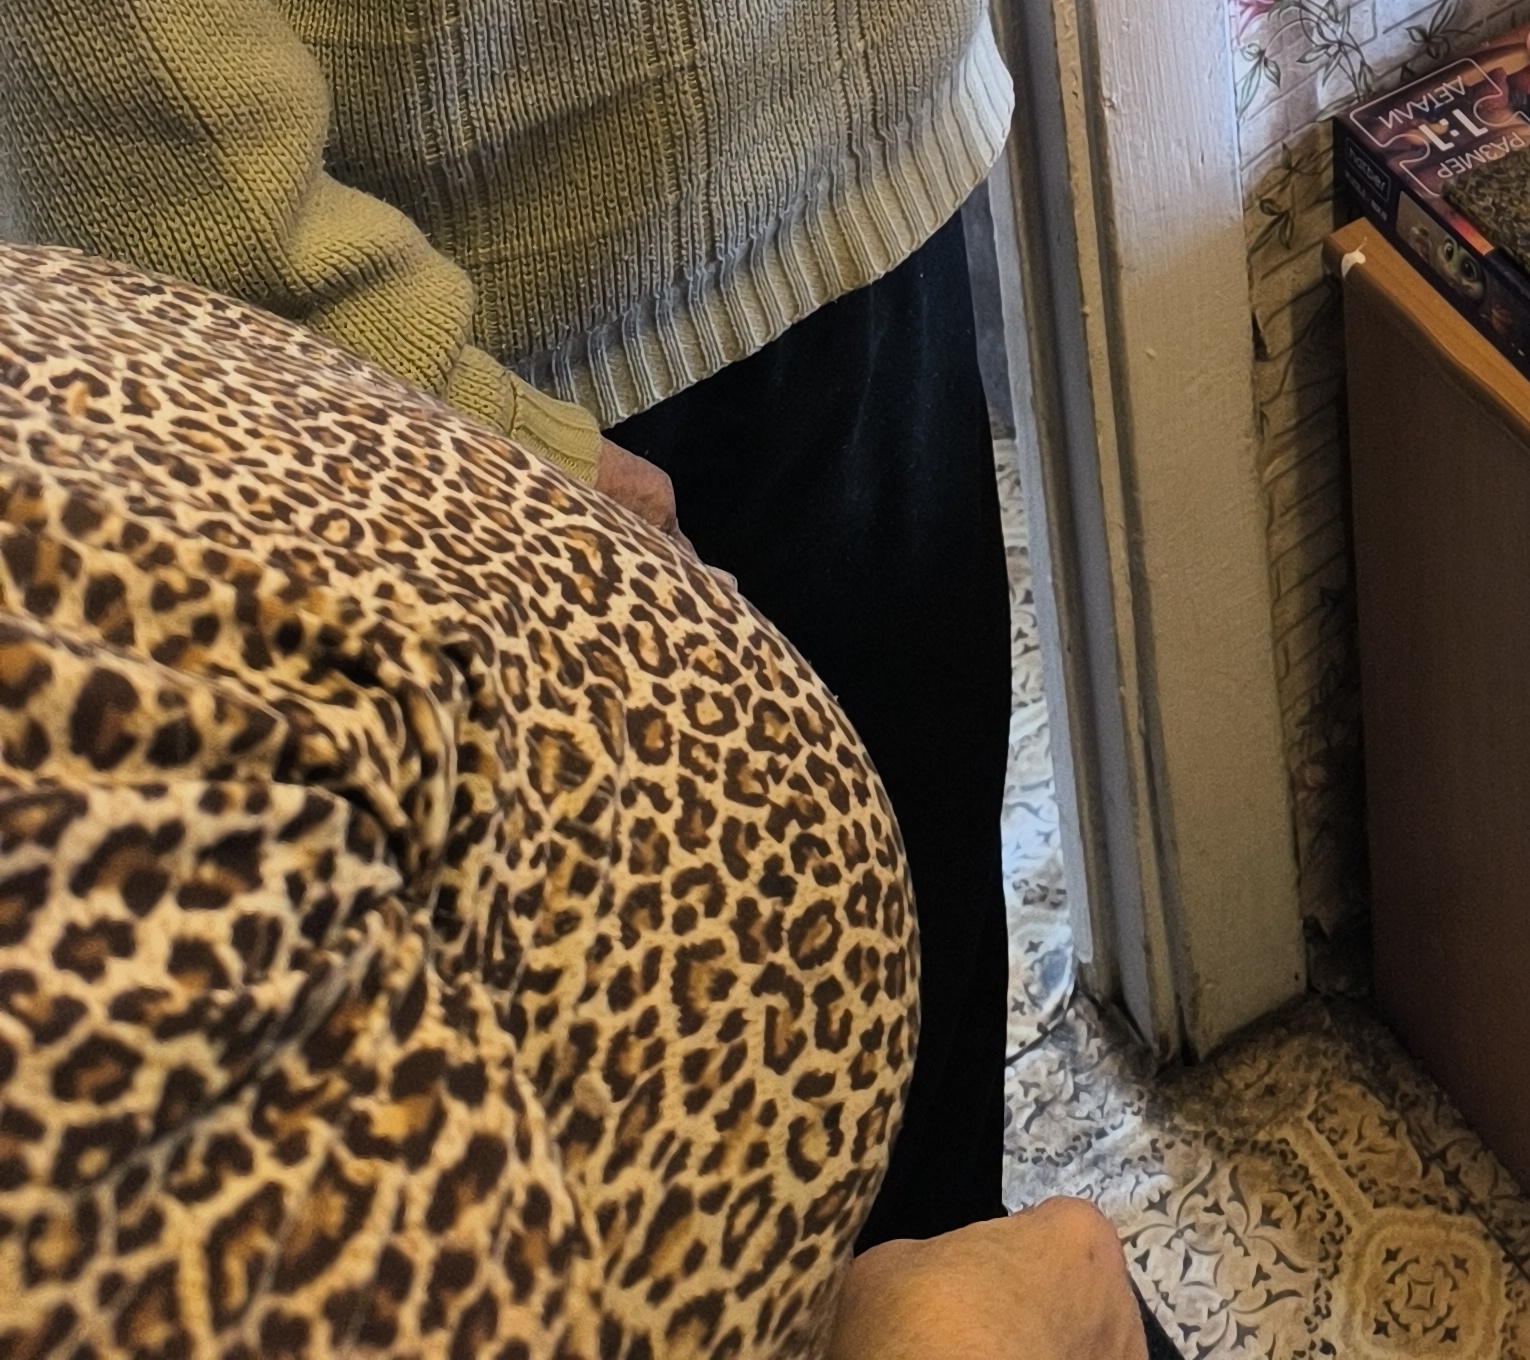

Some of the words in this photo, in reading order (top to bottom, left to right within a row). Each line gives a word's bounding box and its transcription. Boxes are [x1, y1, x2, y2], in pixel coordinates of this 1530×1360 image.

[1378, 75, 1466, 130] ДЕТАЛИ
[1418, 108, 1489, 152] 1:1
[1437, 132, 1526, 180] РАЗМЕР
